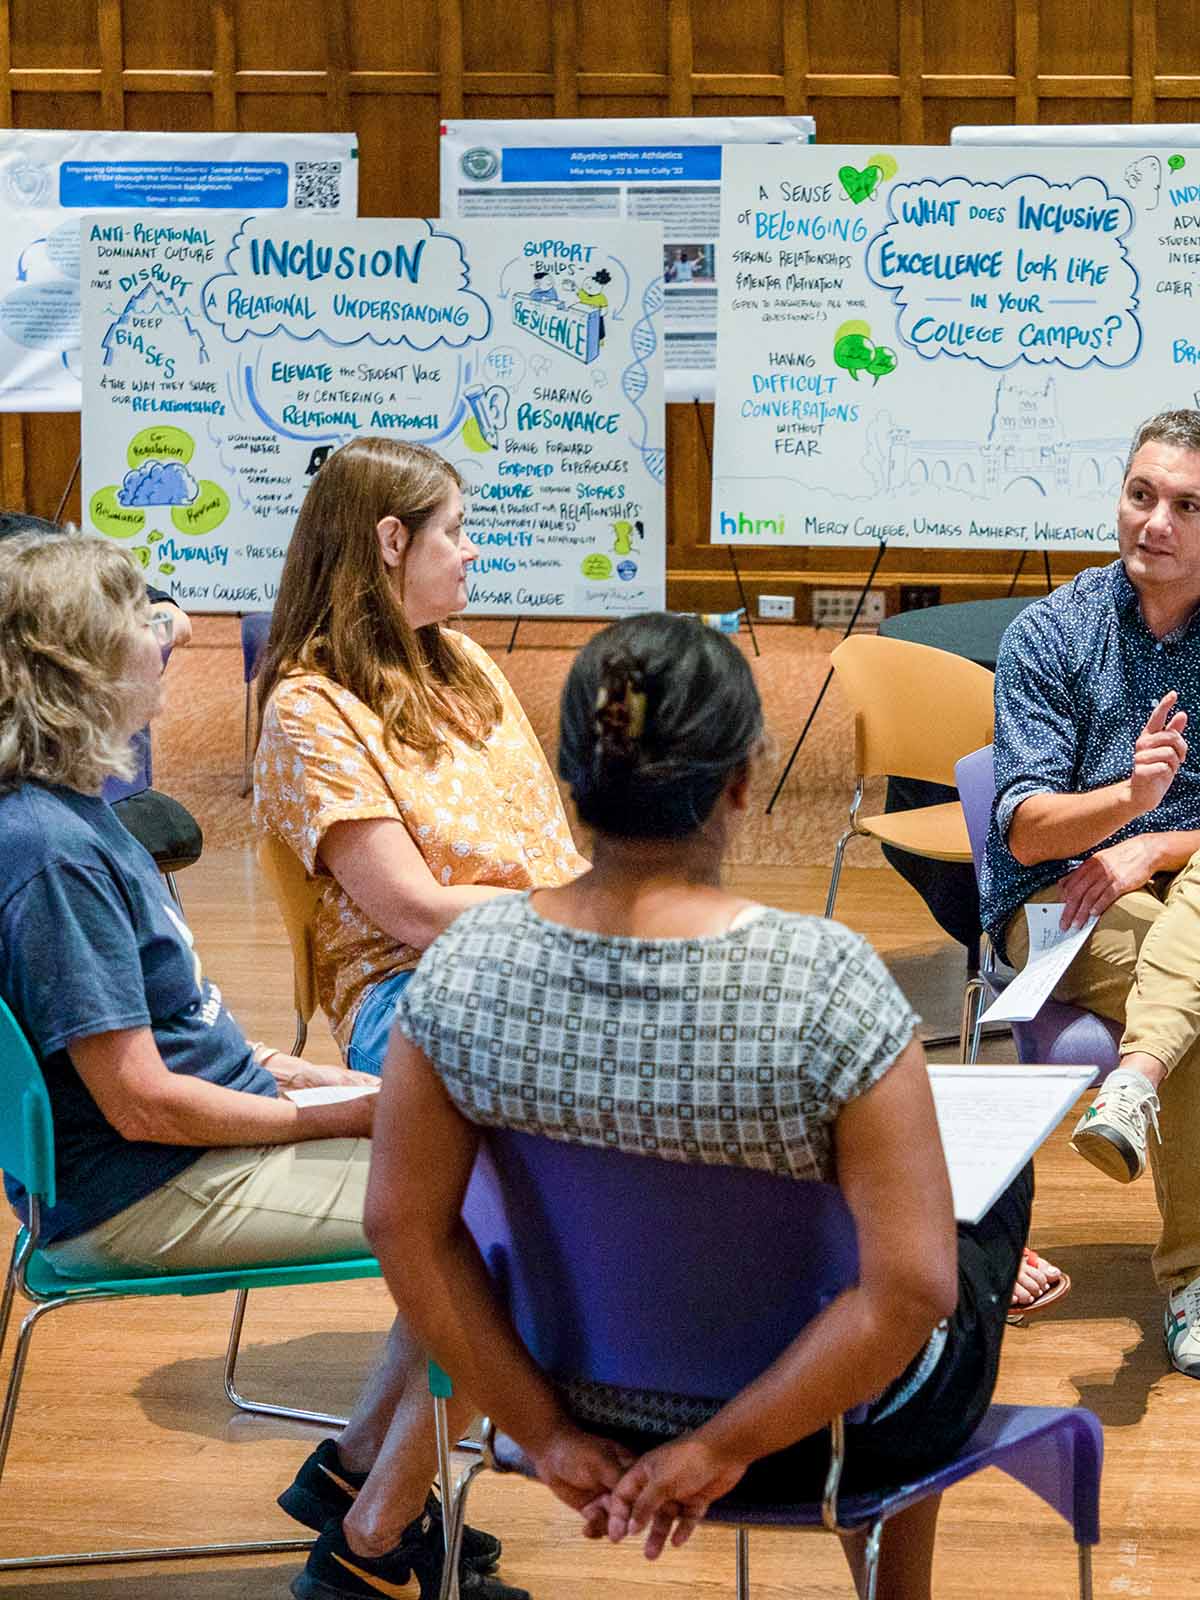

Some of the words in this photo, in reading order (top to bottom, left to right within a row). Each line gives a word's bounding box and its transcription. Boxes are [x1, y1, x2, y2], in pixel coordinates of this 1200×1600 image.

[641, 151, 684, 160] Athletics
[758, 184, 769, 201] A
[779, 181, 833, 203] SENSE
[902, 196, 960, 228] WHAT
[969, 205, 1007, 223] DOES
[1017, 195, 1121, 233] INCLUSIVE
[90, 223, 215, 246] ANTI-RELATIONAL
[755, 209, 868, 243] BELONGING
[97, 246, 157, 259] DOMINANT
[164, 246, 215, 263] CULTURE
[250, 238, 427, 284] INCLUSION
[523, 239, 600, 263] SUPPORT
[731, 249, 773, 264] STRONG
[779, 250, 853, 269] RELATIONSHIPS
[880, 240, 1003, 280] EXCELLENCE
[1016, 248, 1058, 283] LOOK
[119, 263, 192, 297] DISRUPT
[535, 262, 576, 276] BUILDS
[786, 273, 844, 293] MOTIVATION
[1156, 280, 1193, 298] CATER
[206, 293, 217, 307] A
[227, 288, 317, 320] RELATIONAL
[333, 294, 469, 326] UNDERSTANDING
[970, 292, 987, 308] IN
[998, 292, 1044, 314] YOUR
[132, 317, 162, 328] DEEP
[513, 301, 586, 357] RESILIENCE
[911, 317, 1004, 346] COLLEGE
[1018, 314, 1123, 349] CAMPUS?
[769, 352, 816, 369] HAVING
[271, 362, 333, 384] ELEVATE
[357, 363, 408, 383] STUDENT
[132, 377, 155, 392] WAY
[160, 379, 184, 391] THEY
[189, 380, 217, 393] SHAPE
[313, 388, 384, 404] CENTERING
[533, 387, 593, 404] SHARING
[751, 374, 838, 396] DIFFICULT
[132, 396, 225, 416] RELATIONSHIPS
[740, 399, 860, 423] CONVERSATIONS
[283, 405, 362, 430] RELATIONAL
[370, 410, 439, 431] APPROACH
[517, 402, 621, 434] RESONANCE
[776, 423, 825, 436] WITHOUT
[546, 440, 593, 454] FORWARD
[774, 438, 822, 457] FEAR
[480, 482, 533, 499] CULTURE
[560, 502, 641, 523] RELATIONSHIPS
[719, 511, 785, 536] hhmi
[804, 516, 849, 536] MERCY
[913, 518, 962, 537] UMASS
[969, 521, 1029, 541] AMHERST,
[1034, 520, 1095, 544] WHEATON
[158, 538, 229, 566] MUTUALITY
[170, 580, 210, 599] MERCY
